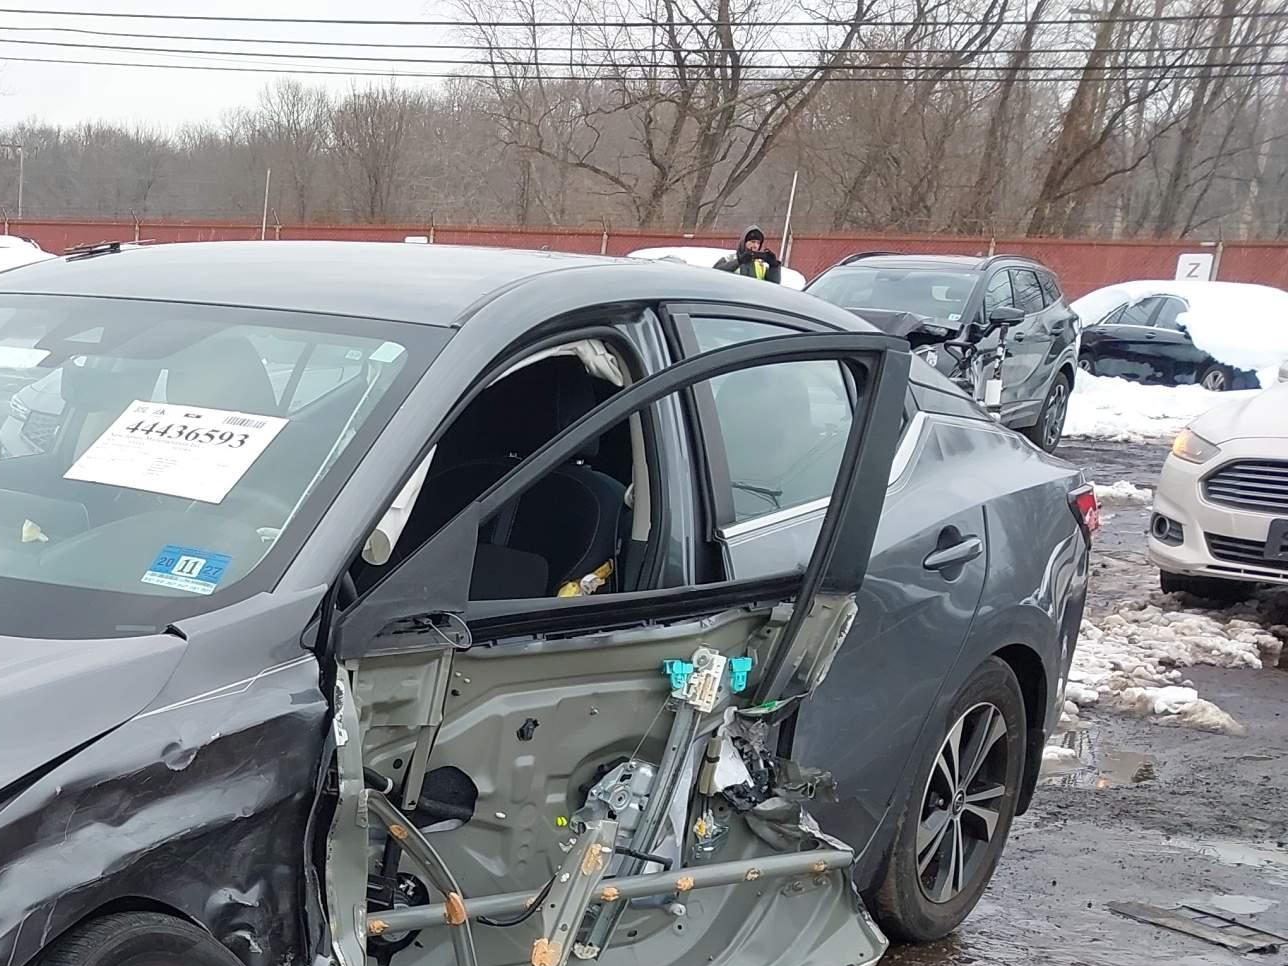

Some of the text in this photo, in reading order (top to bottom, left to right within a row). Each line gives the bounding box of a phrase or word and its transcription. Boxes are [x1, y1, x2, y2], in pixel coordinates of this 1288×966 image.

[1185, 262, 1201, 278] Z
[126, 420, 250, 449] 44436593
[177, 558, 200, 575] 11
[202, 565, 223, 576] 27
